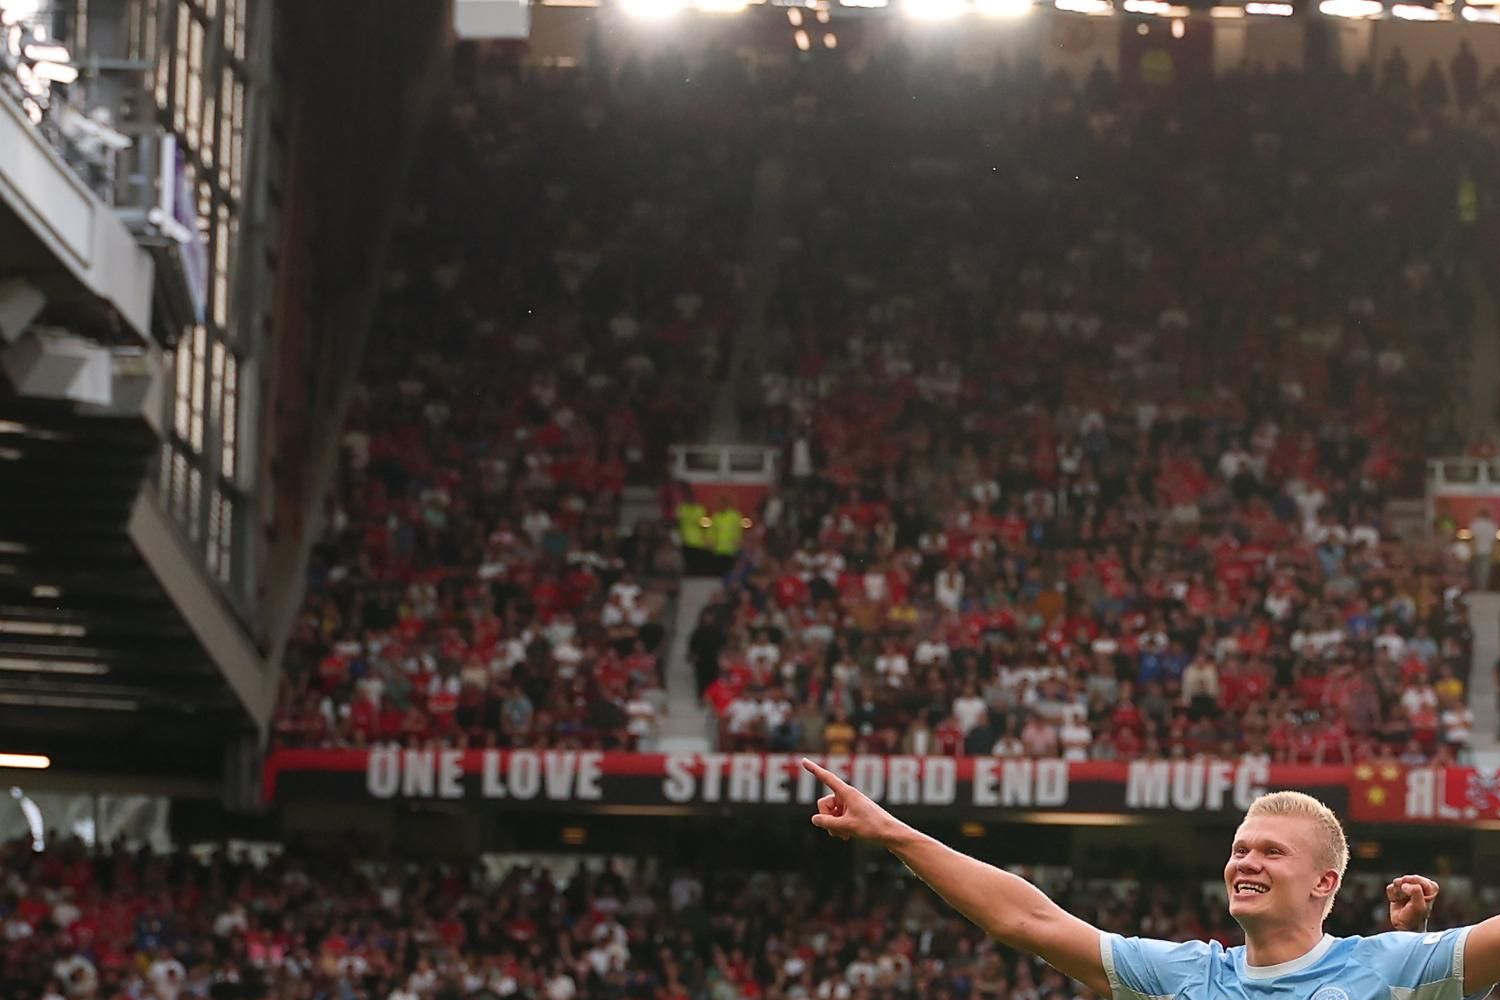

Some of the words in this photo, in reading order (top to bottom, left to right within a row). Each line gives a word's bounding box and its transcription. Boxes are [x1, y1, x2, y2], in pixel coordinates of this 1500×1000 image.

[366, 748, 463, 798] ONE
[482, 752, 602, 799] LOVE
[972, 759, 1069, 806] END
[1125, 754, 1270, 811] MUFC
